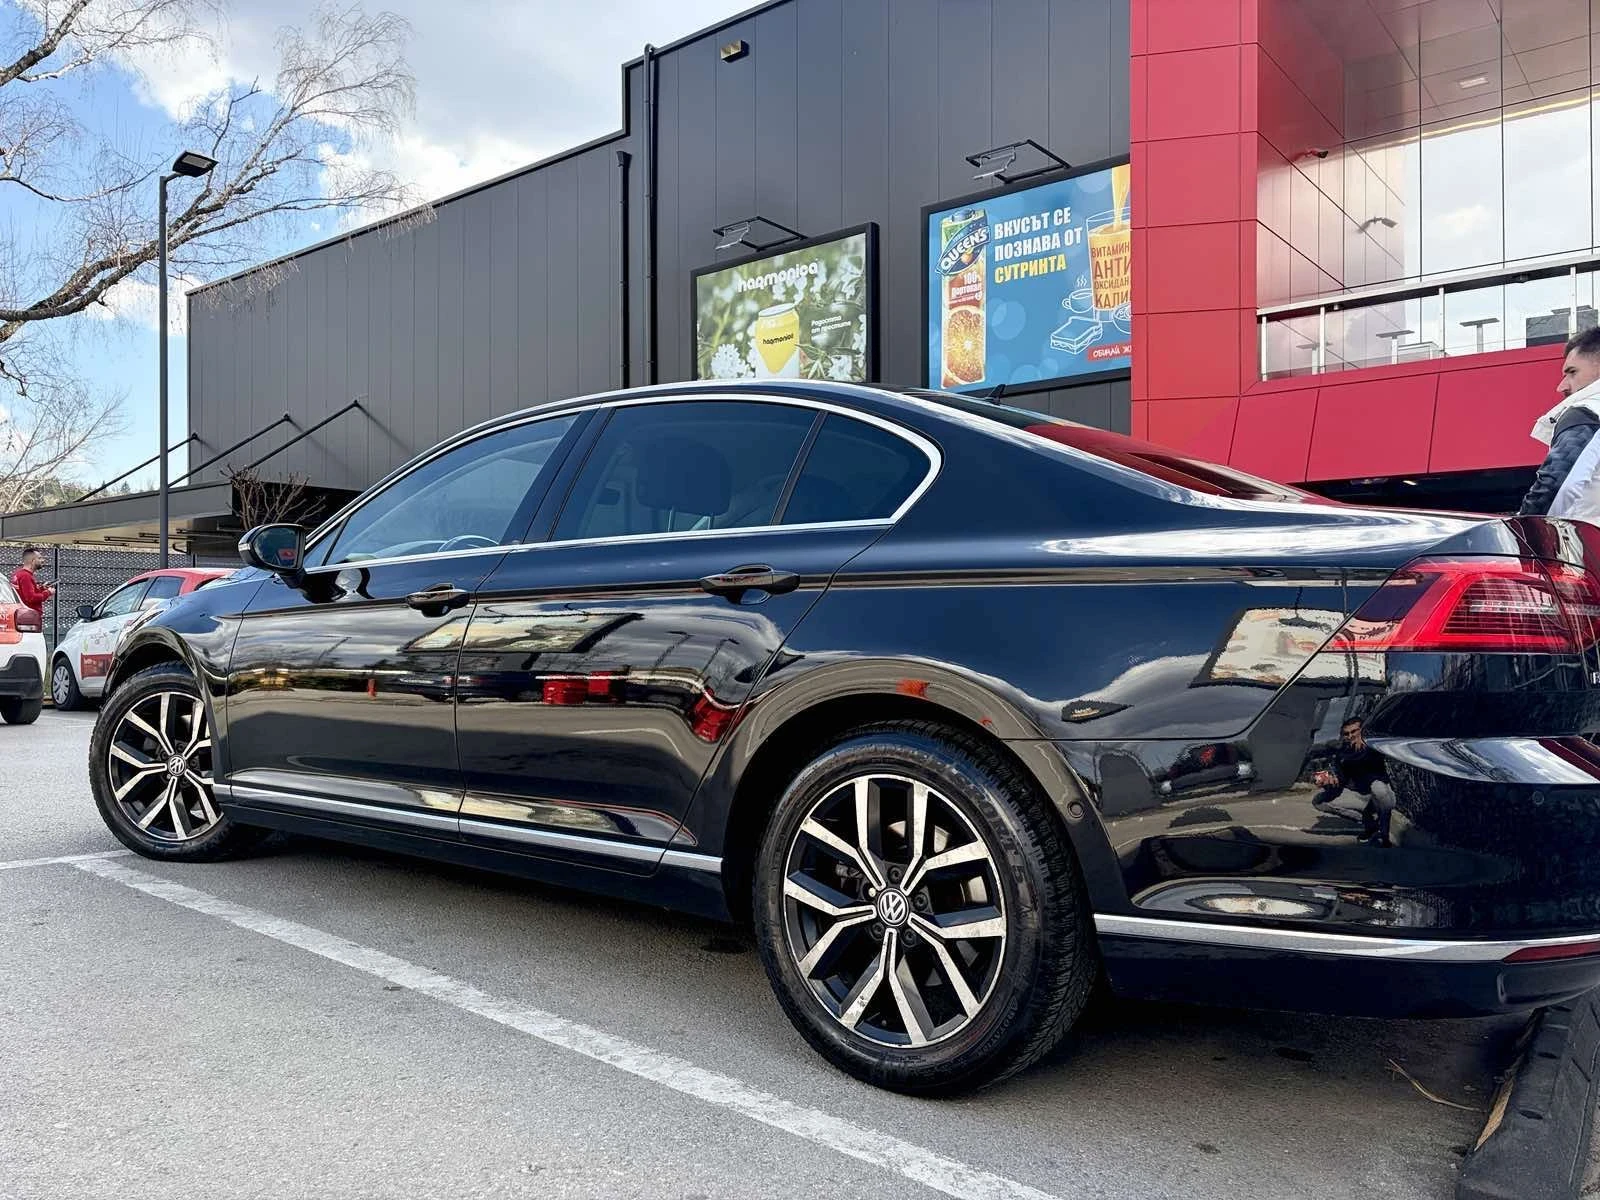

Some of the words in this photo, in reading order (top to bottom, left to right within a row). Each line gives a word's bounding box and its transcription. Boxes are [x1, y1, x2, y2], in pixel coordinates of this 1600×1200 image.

[994, 211, 1050, 240] ВКУСЪТ
[1053, 207, 1071, 226] СЕ
[994, 232, 1061, 262] ПОЗНАВА
[1064, 227, 1082, 246] ОТ
[994, 253, 1067, 284] СУТРИНТА
